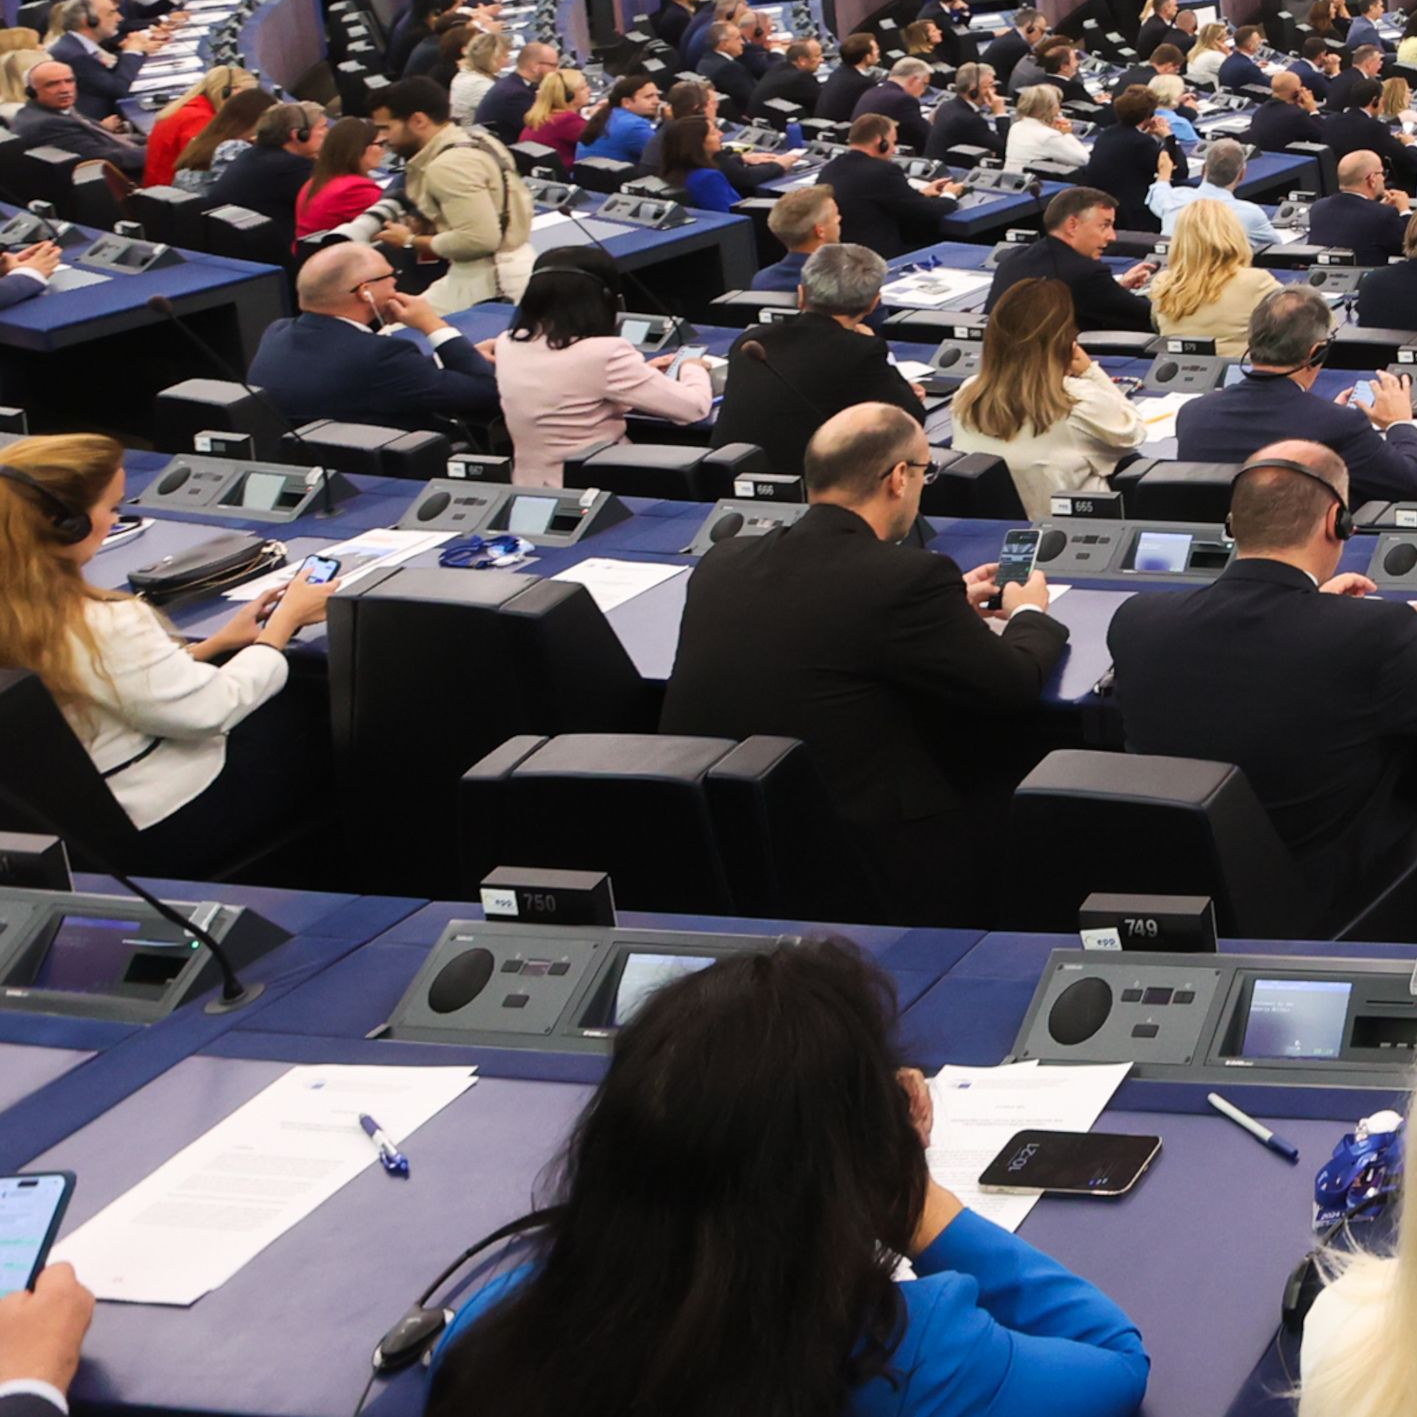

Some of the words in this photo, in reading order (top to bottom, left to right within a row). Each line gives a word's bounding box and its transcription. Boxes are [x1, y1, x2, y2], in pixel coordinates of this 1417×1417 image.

[757, 484, 774, 496] 666
[1075, 500, 1093, 512] 665
[495, 897, 513, 909] epp
[523, 892, 556, 912] 750
[1124, 918, 1158, 937] 749
[1096, 937, 1116, 949] epp
[1008, 1143, 1040, 1171] 10:21
